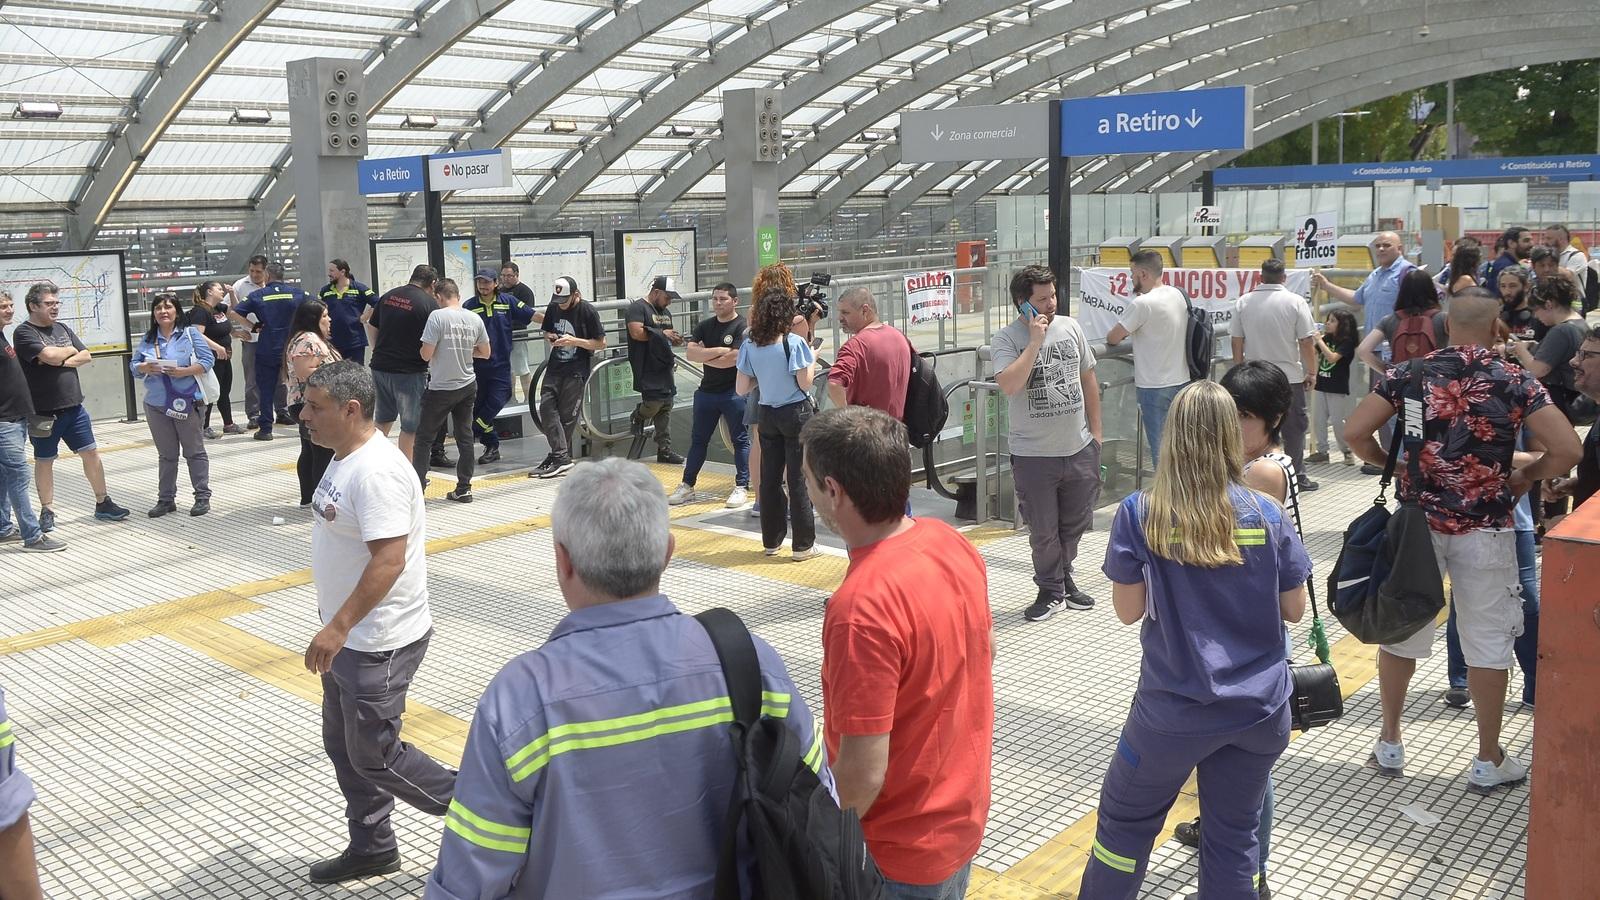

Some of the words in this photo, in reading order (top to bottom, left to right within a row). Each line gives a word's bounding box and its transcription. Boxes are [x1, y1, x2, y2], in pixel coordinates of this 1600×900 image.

[1098, 118, 1110, 134] a
[1116, 111, 1180, 133] Retiro
[949, 129, 971, 141] Zona
[973, 126, 1017, 140] comercial
[451, 163, 464, 176] No
[465, 164, 490, 179] pasar
[1359, 166, 1402, 175] Constitución
[1409, 165, 1432, 174] Retiro
[1508, 159, 1558, 170] Constitución
[1565, 159, 1591, 169] Retiro
[379, 171, 385, 181] a
[386, 168, 411, 181] Retiro
[1193, 216, 1220, 224] francos
[1295, 244, 1335, 260] francos
[1404, 398, 1424, 439] NIKE
